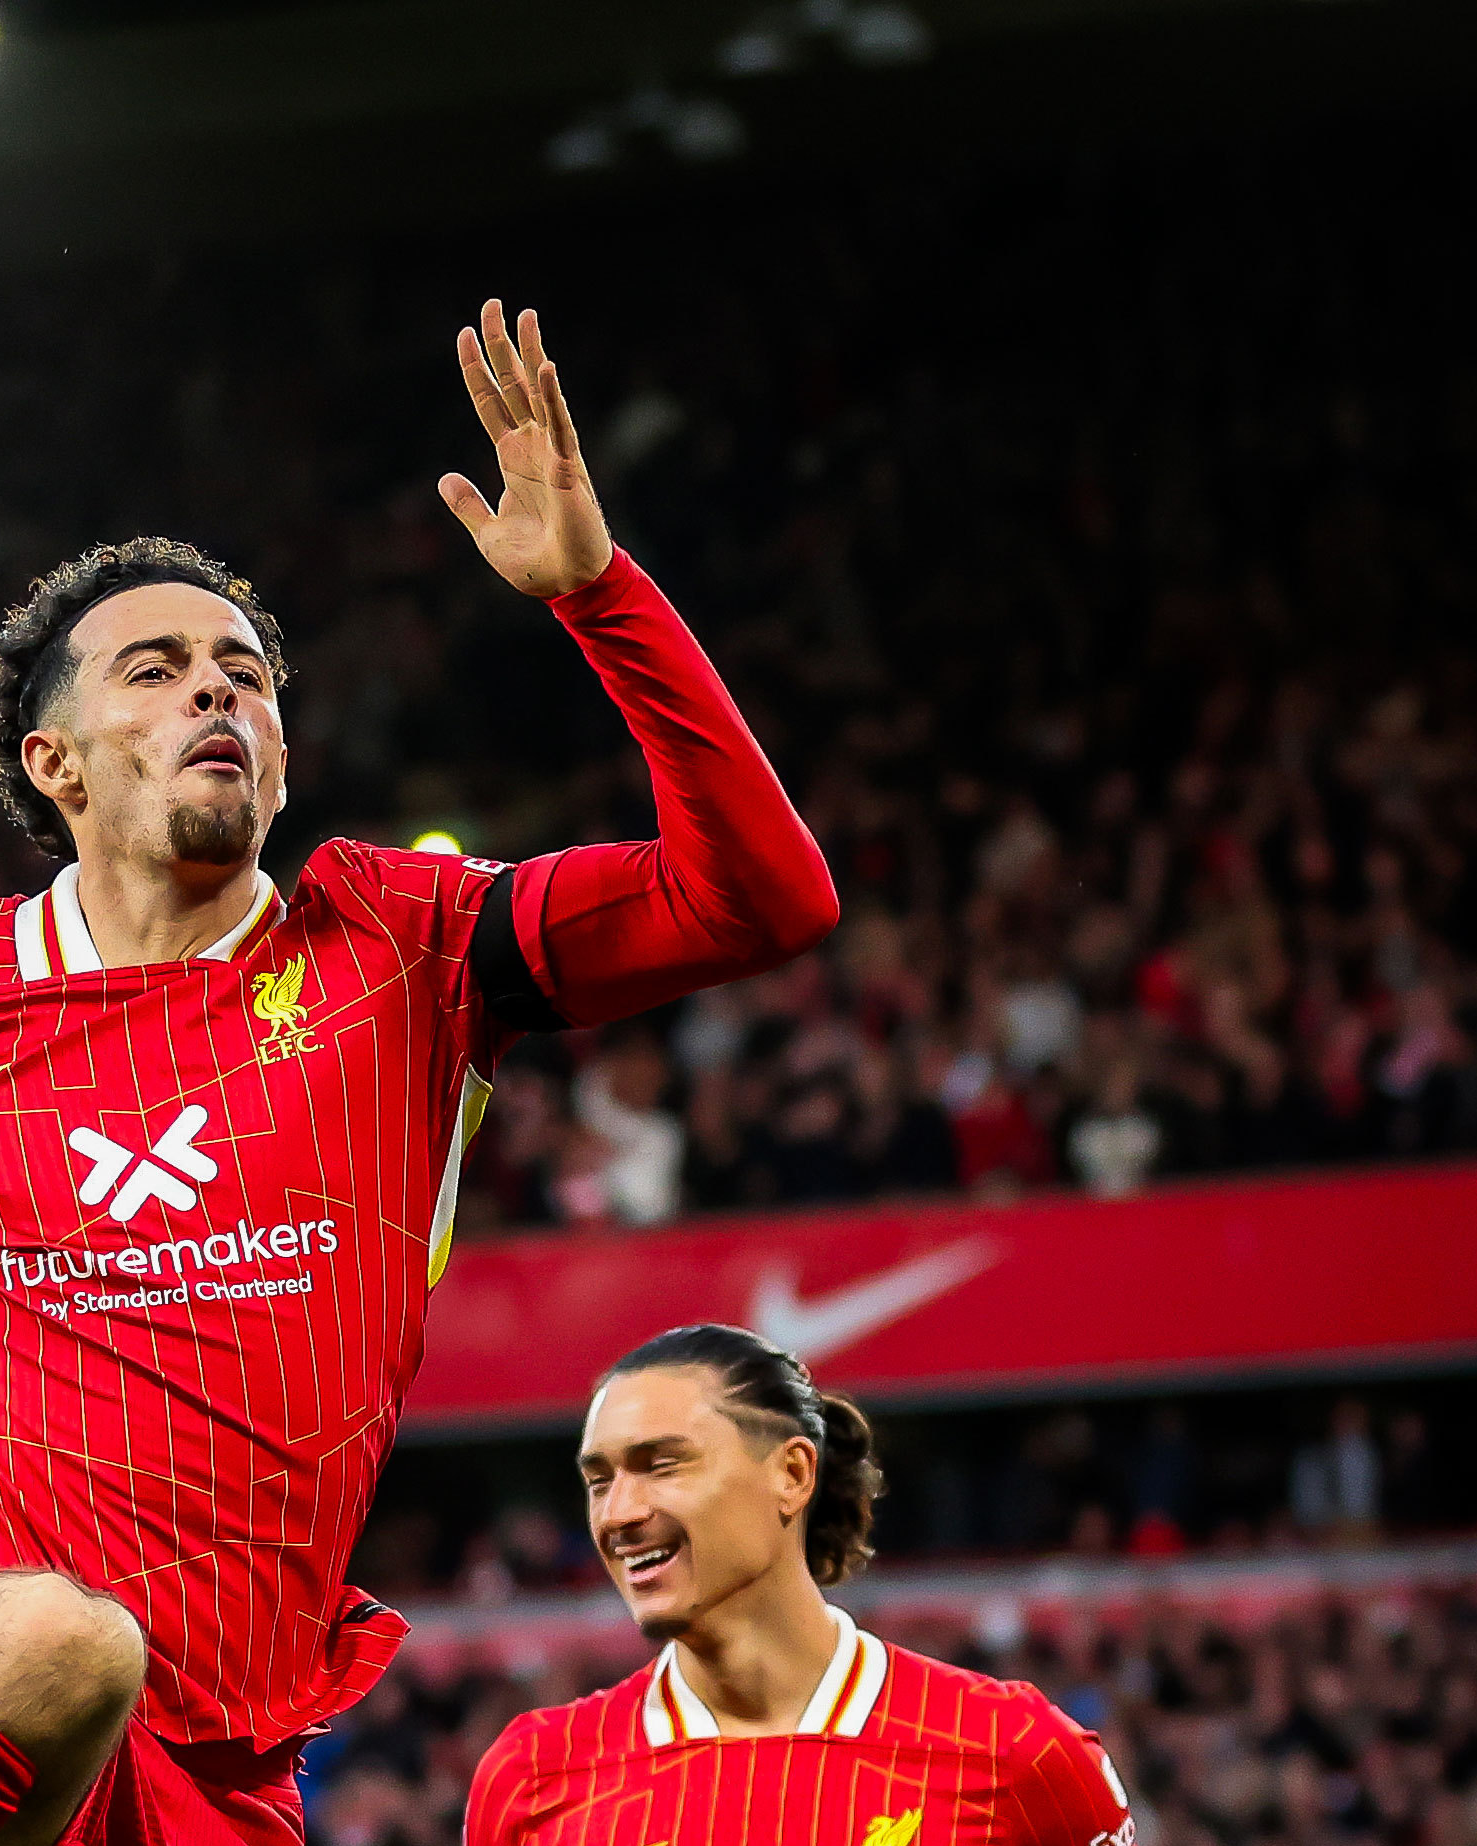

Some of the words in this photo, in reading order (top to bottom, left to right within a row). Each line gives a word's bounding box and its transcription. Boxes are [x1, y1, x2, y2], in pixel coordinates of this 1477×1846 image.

[0, 1218, 339, 1291] futuremakers
[40, 1299, 70, 1321] by
[73, 1281, 190, 1315] Standard
[194, 1270, 314, 1300] Chartered
